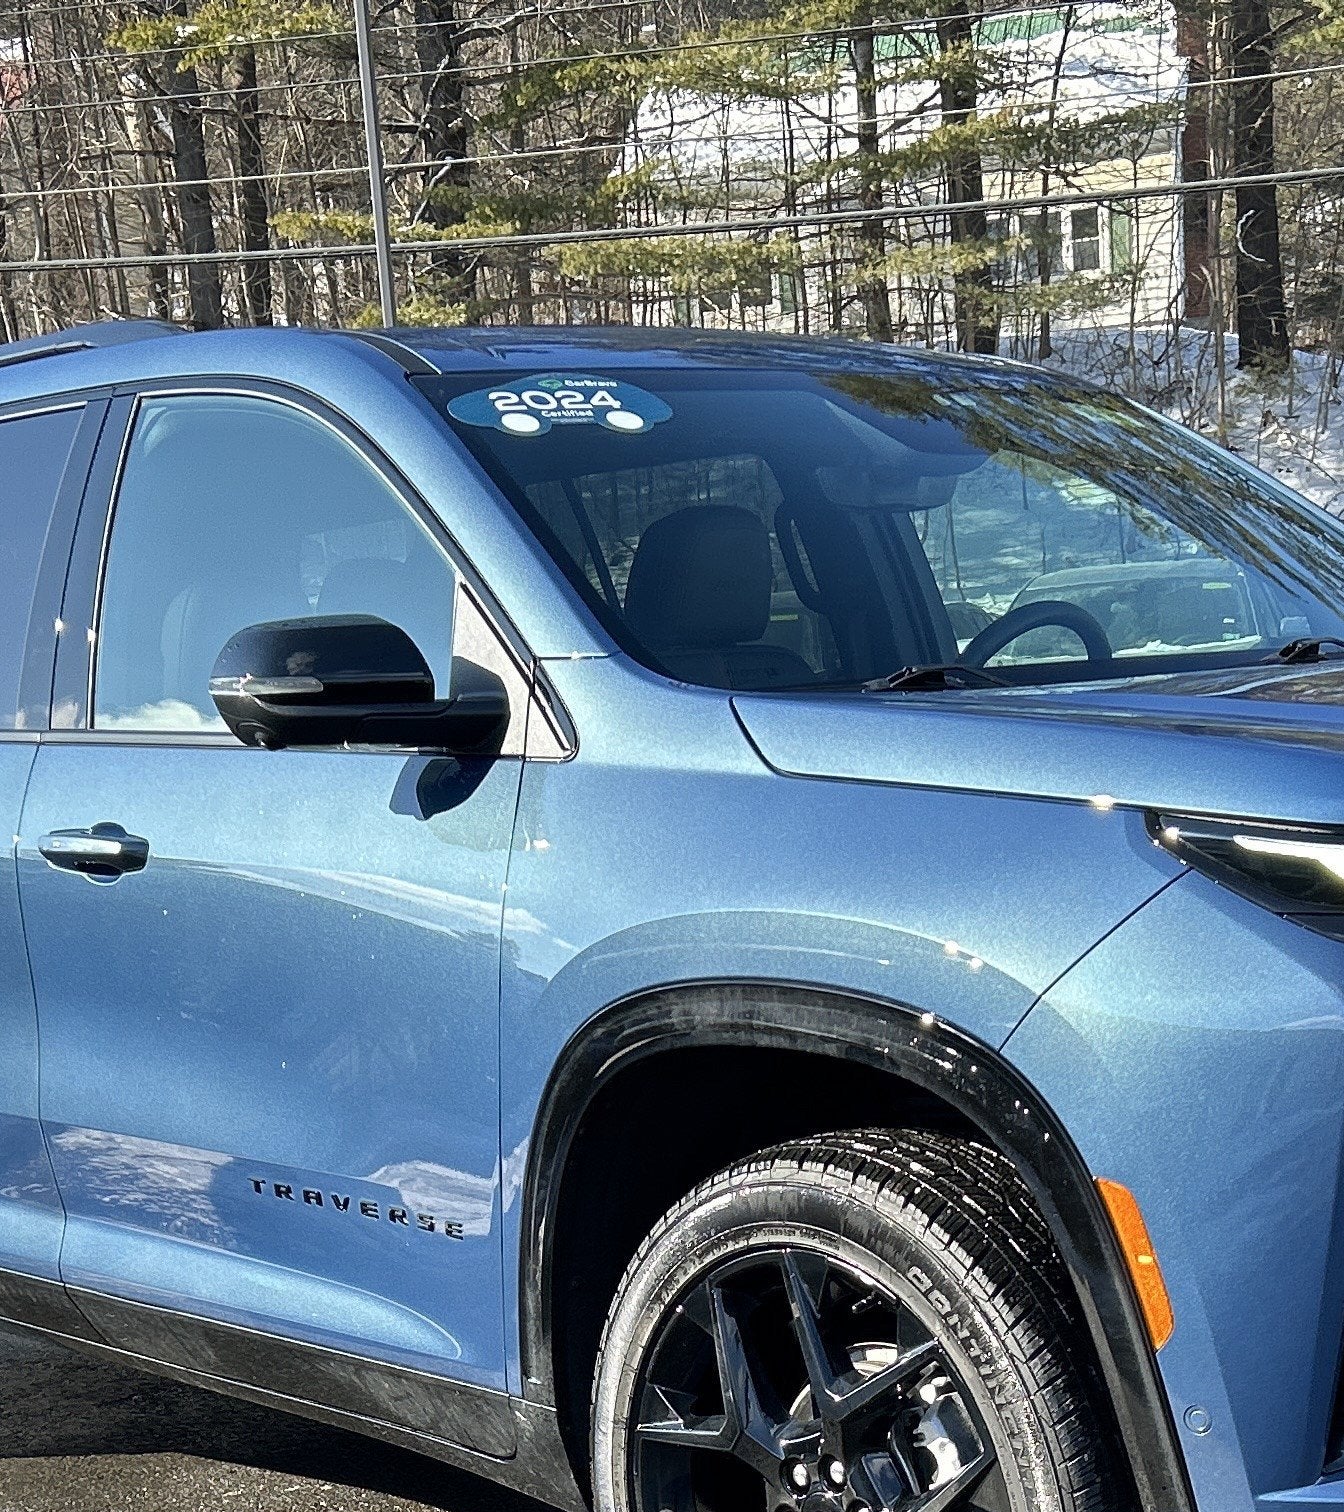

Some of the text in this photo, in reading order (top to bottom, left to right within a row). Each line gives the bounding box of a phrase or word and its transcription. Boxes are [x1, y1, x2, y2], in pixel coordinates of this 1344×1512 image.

[488, 390, 622, 411] 2024
[541, 409, 594, 418] Certified
[247, 1177, 464, 1241] TRAVERSE
